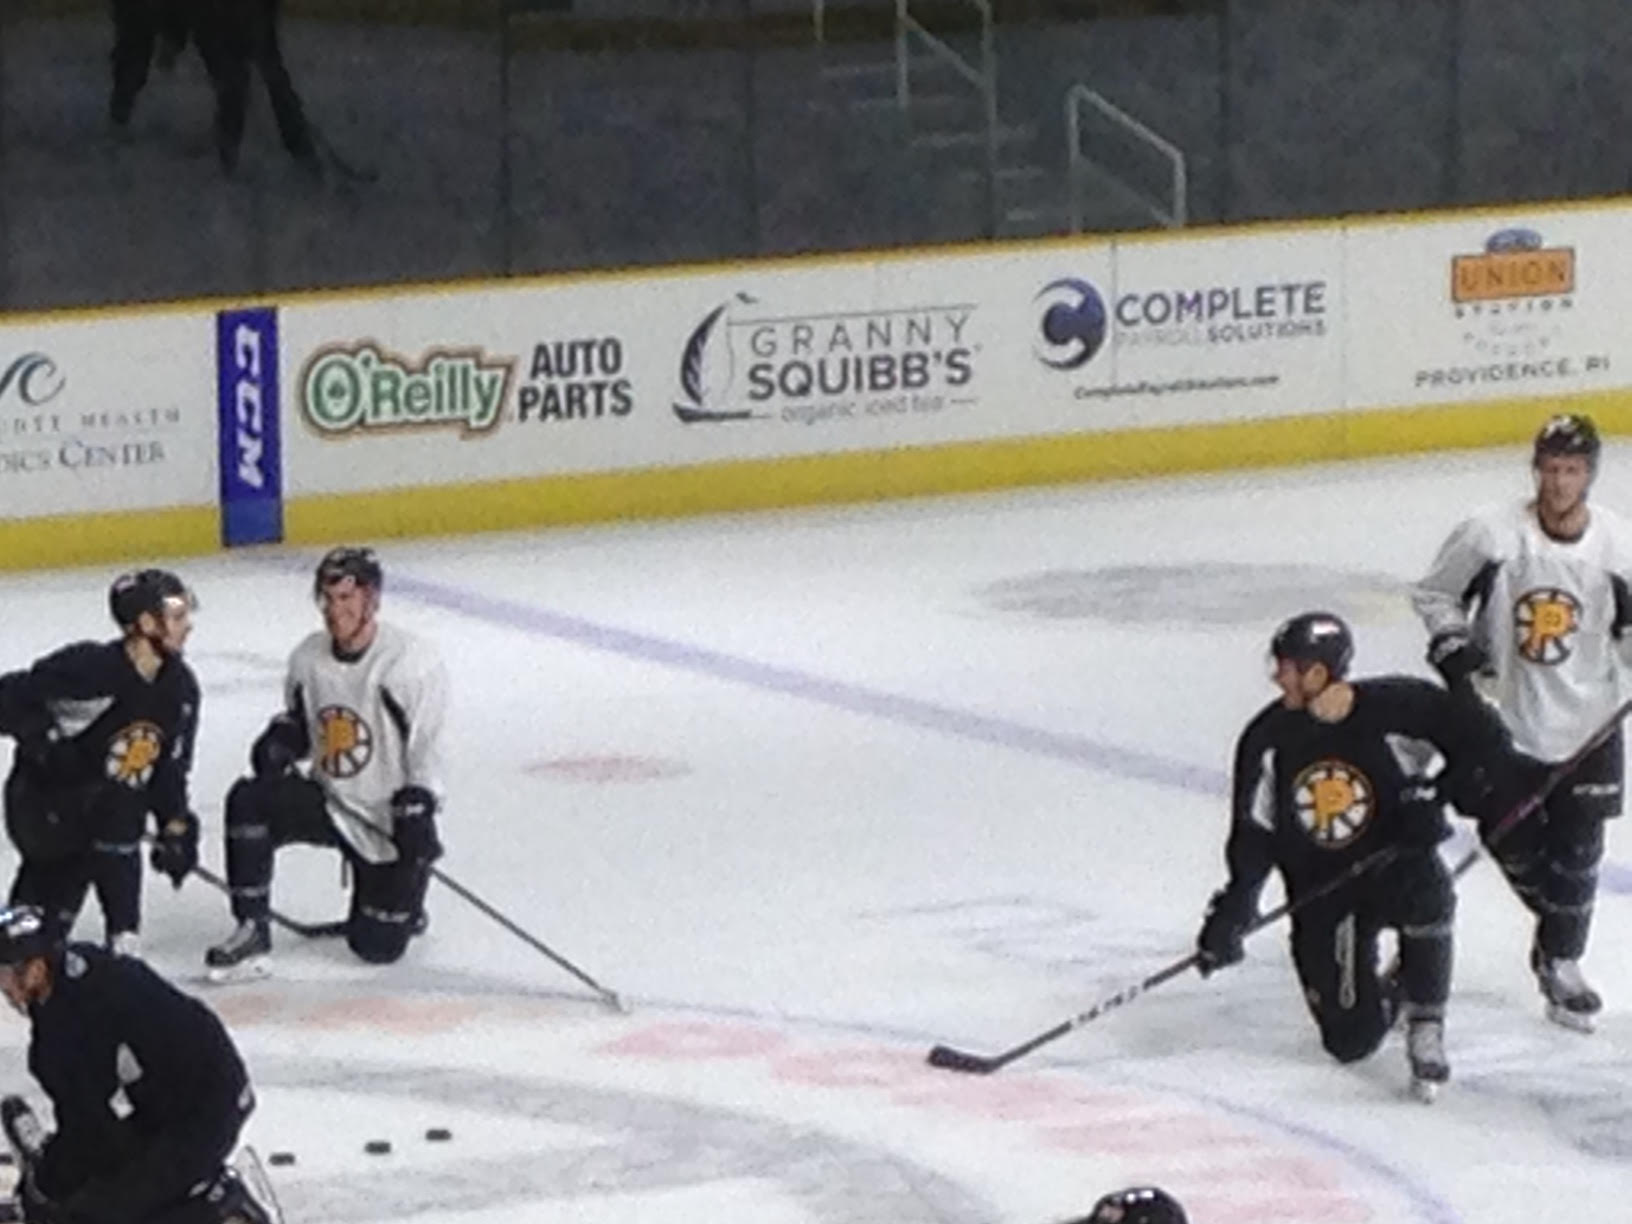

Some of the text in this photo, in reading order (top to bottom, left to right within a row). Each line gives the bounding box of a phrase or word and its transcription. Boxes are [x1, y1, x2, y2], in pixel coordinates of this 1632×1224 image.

[1459, 260, 1567, 292] UNION
[1116, 281, 1328, 327] COMPLETE
[750, 314, 969, 358] GRANNY
[529, 337, 624, 380] AUTO
[747, 347, 974, 401] SQUIBB'S
[234, 323, 264, 488] CCM
[306, 347, 508, 430] O'Reilly
[518, 380, 634, 423] PARTS
[81, 406, 182, 427] HEALTH
